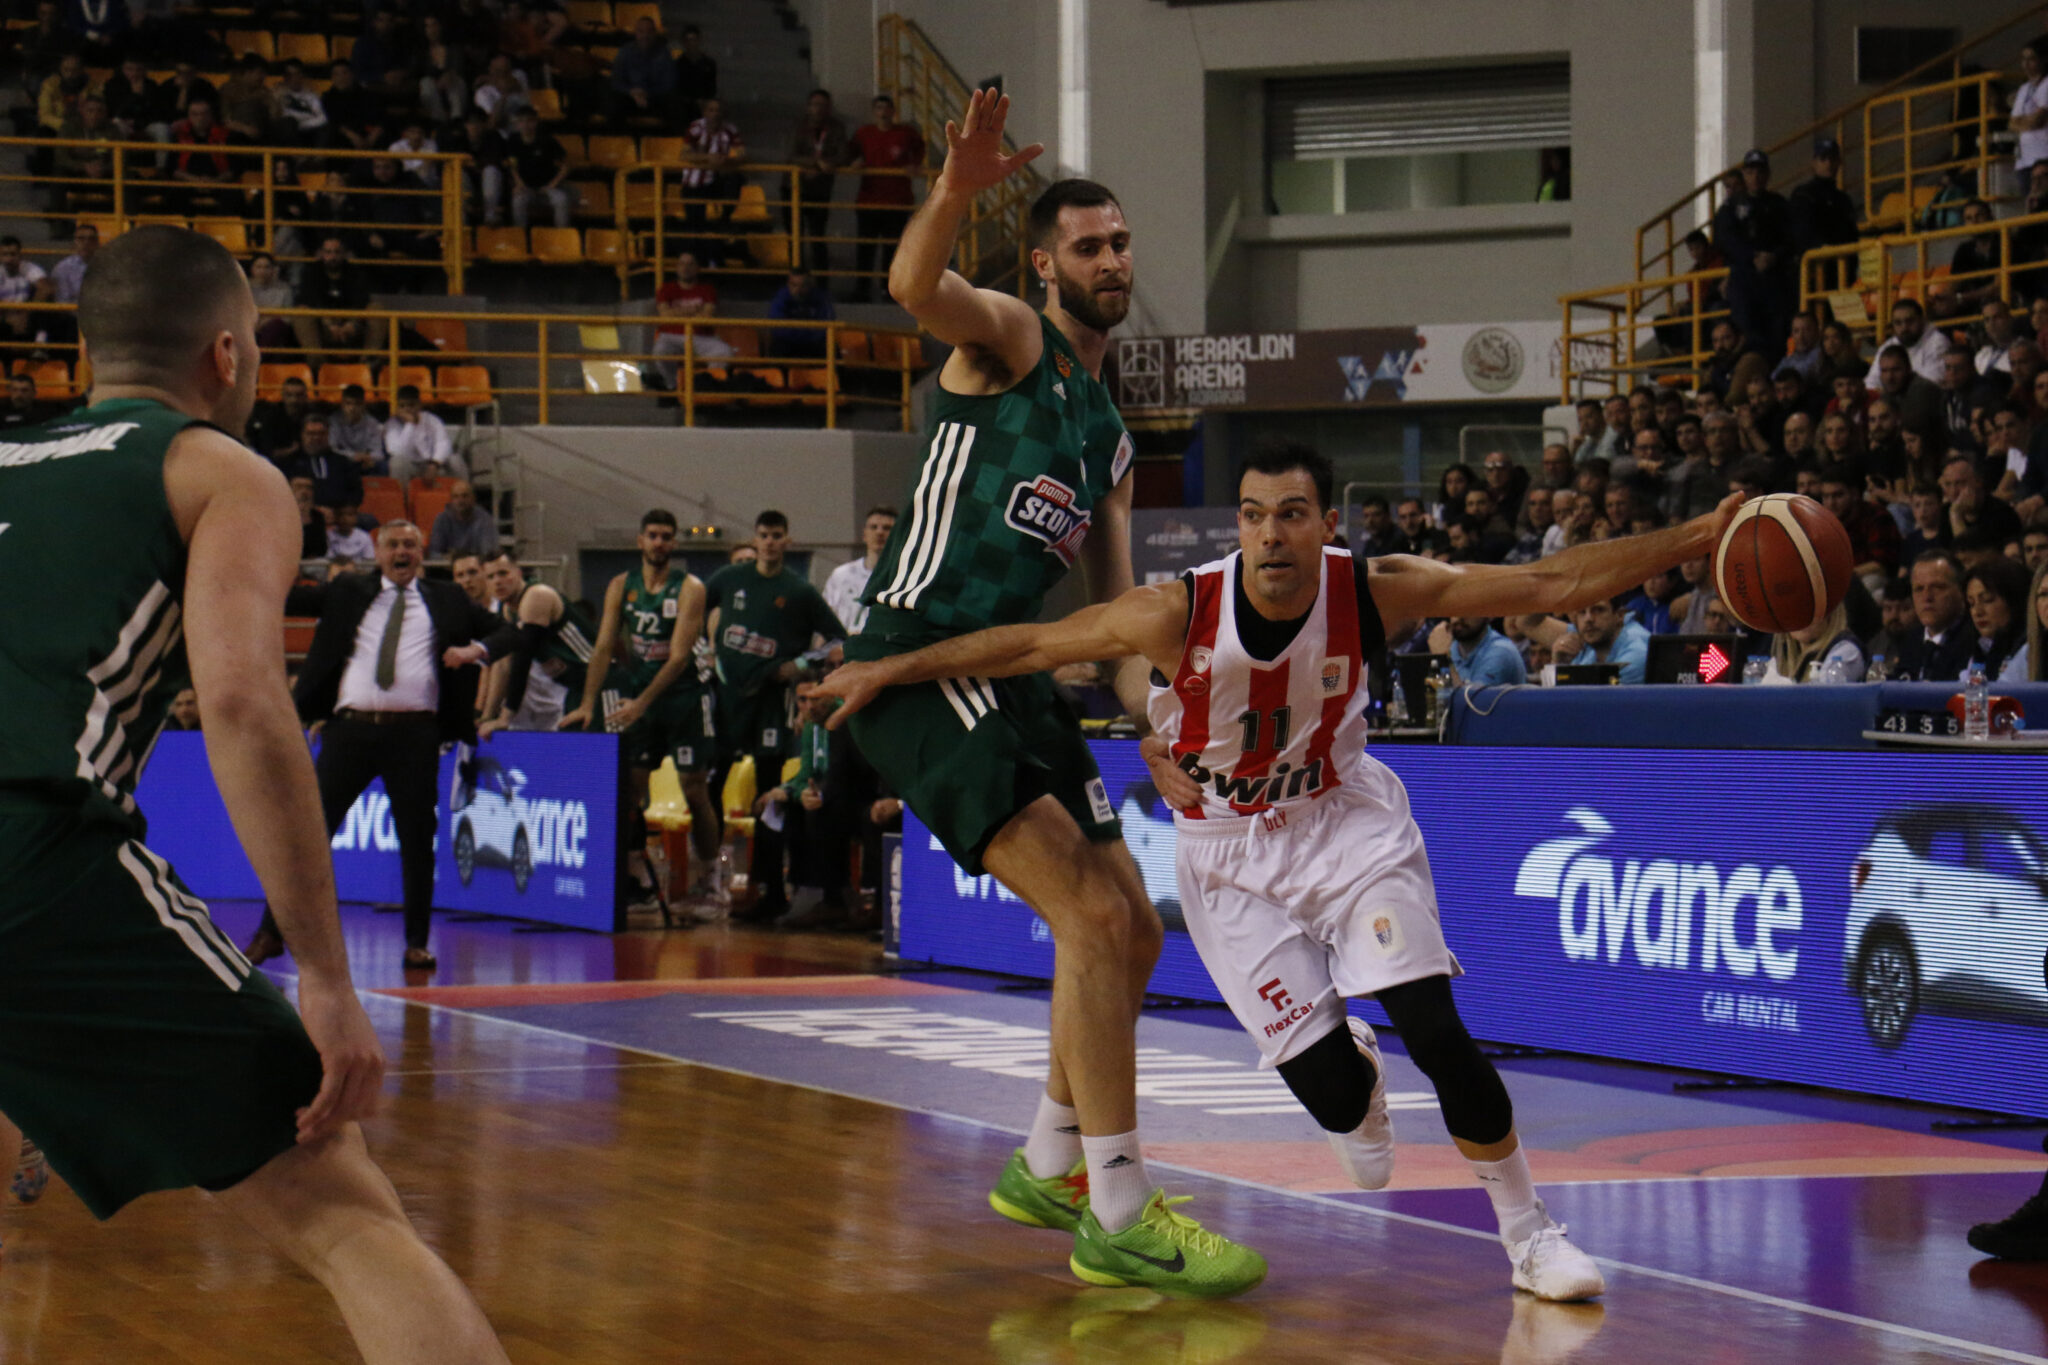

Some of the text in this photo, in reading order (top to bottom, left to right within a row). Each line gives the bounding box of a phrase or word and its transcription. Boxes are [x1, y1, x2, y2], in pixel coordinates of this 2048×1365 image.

[1174, 334, 1296, 363] HERAKLION
[1174, 363, 1246, 389] ARENA
[634, 610, 661, 634] 72
[1238, 706, 1291, 753] 11
[1178, 752, 1323, 805] bwin
[1559, 854, 1803, 980] avance
[1264, 1001, 1316, 1038] FlexCar
[1701, 991, 1800, 1033] CAR RENTAL
